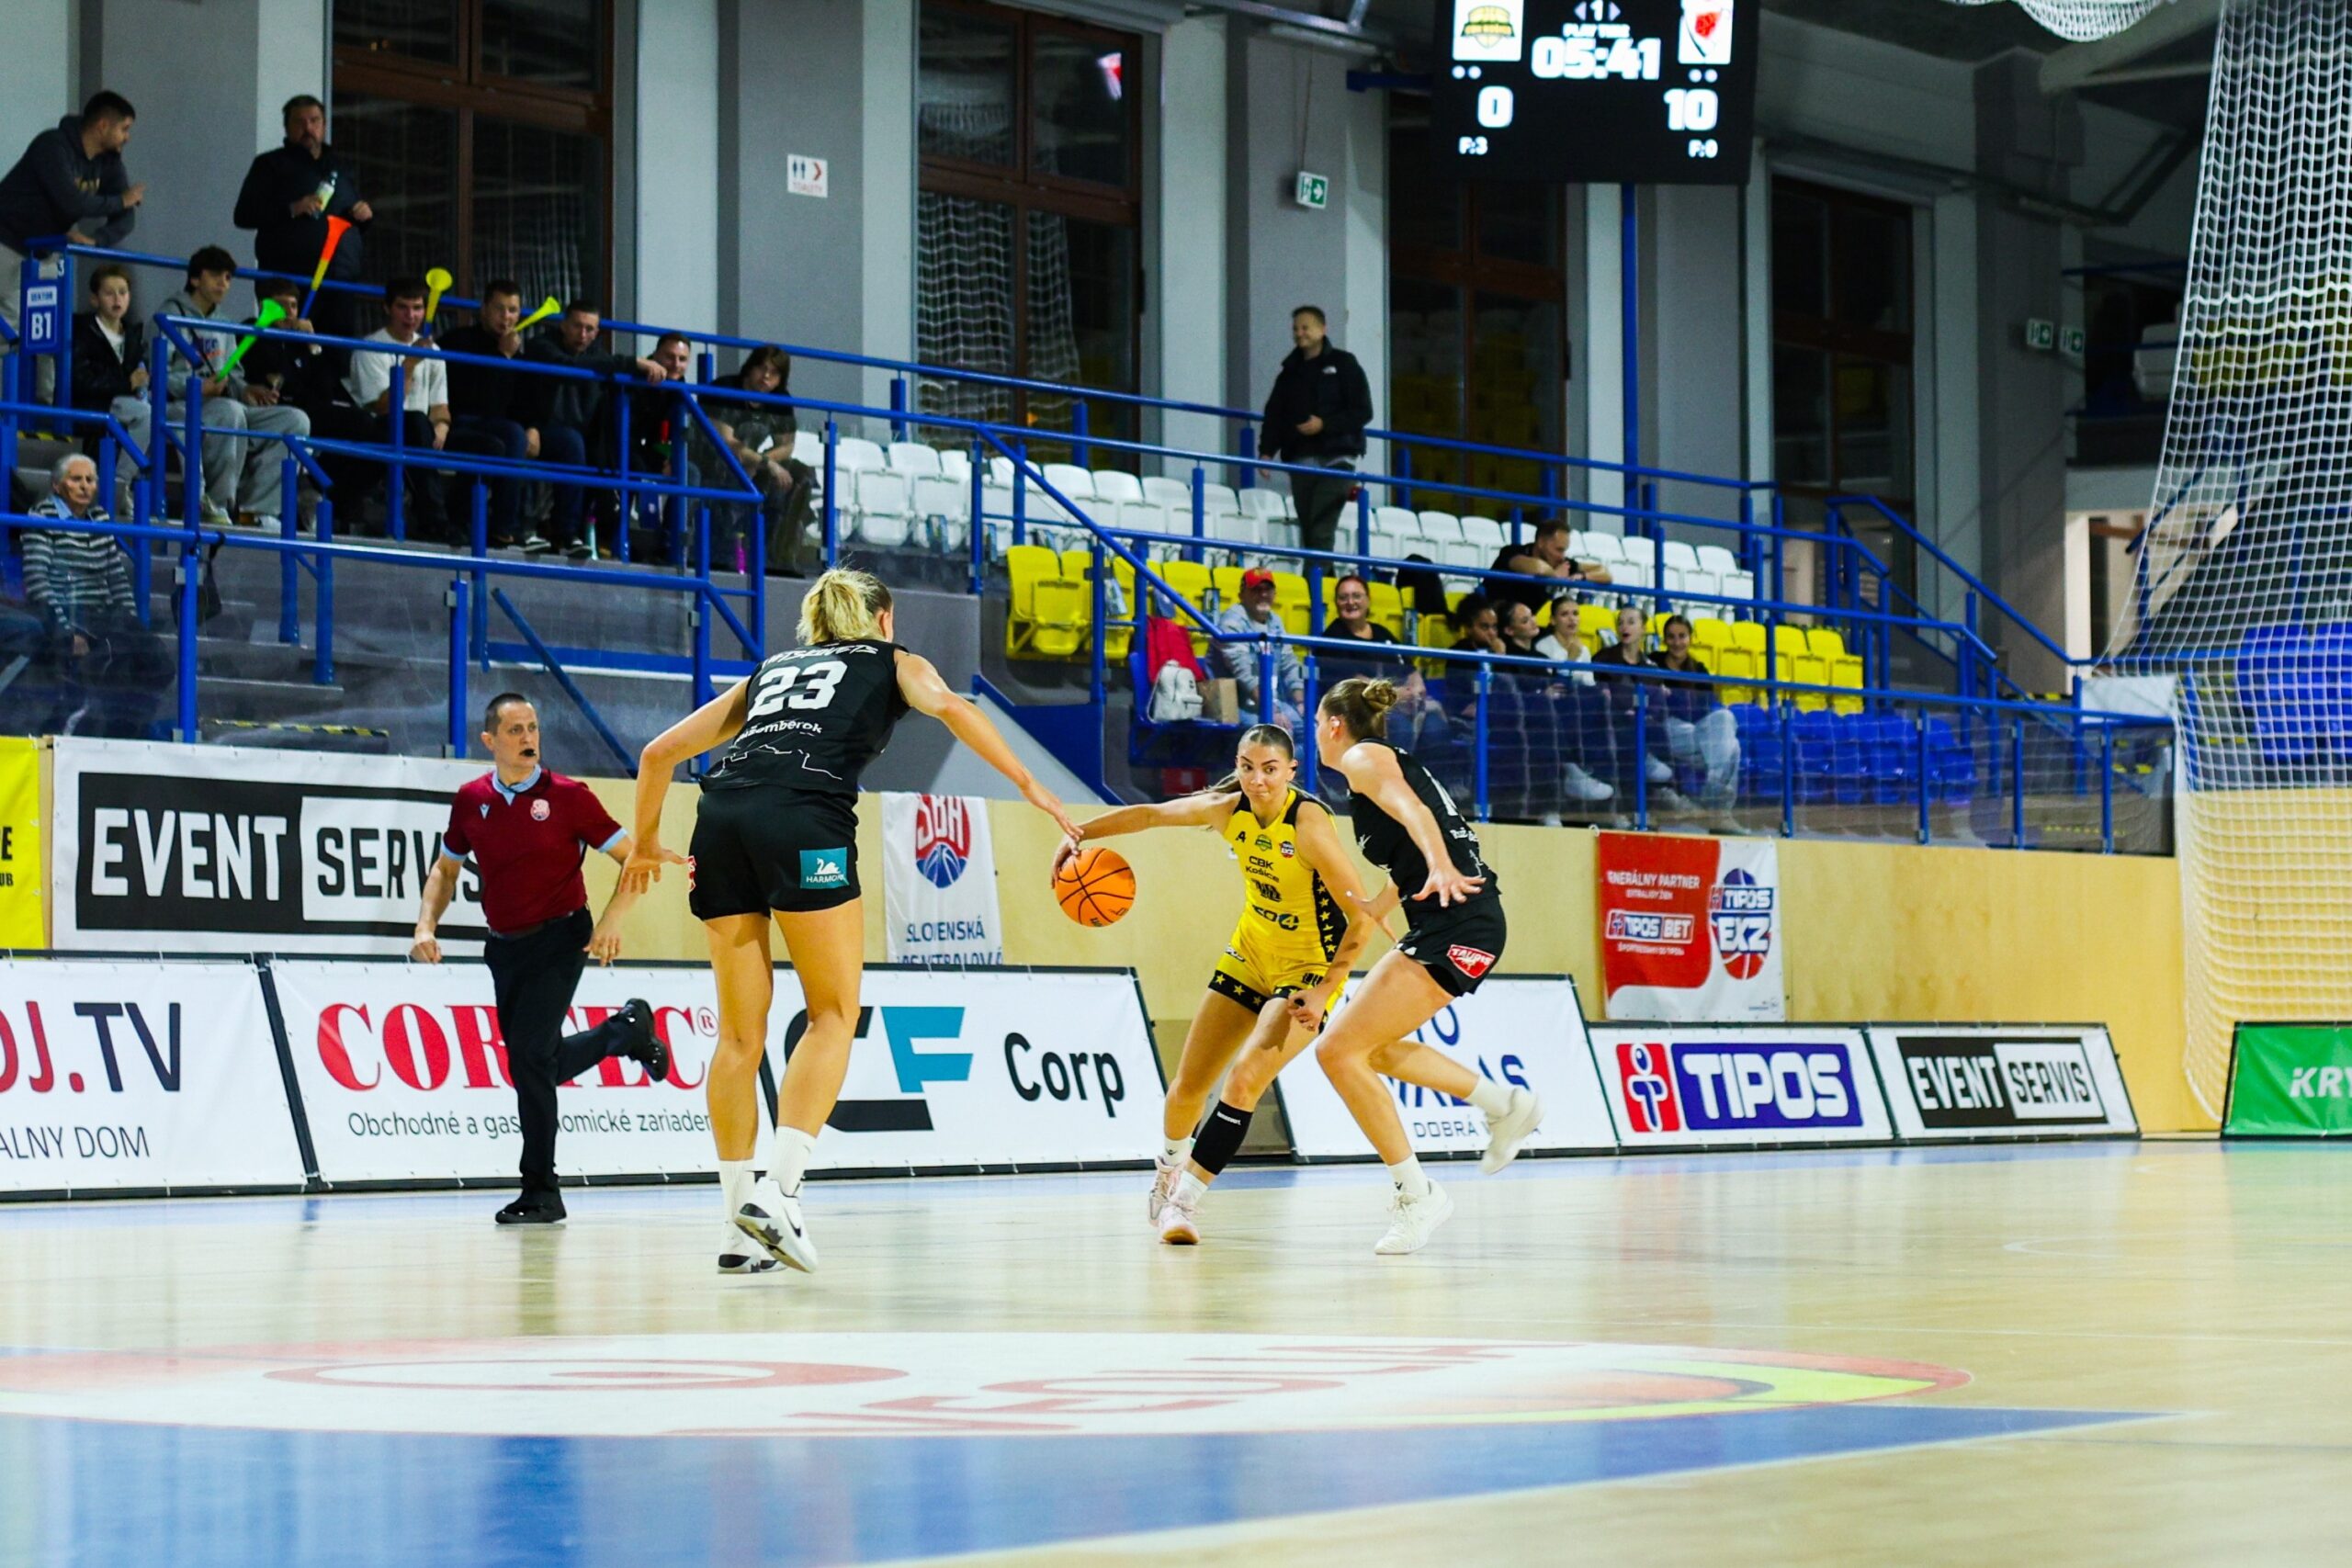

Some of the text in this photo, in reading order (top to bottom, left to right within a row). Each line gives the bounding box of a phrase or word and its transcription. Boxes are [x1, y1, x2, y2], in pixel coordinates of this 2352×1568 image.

[1589, 0, 1603, 21] 1
[1531, 37, 1661, 80] 05:41
[1477, 86, 1514, 128] 0
[1663, 89, 1718, 130] 10
[31, 311, 52, 341] B1
[747, 660, 848, 722] 23
[91, 807, 485, 903] EVENT SERVS
[1249, 855, 1274, 871] CBK
[1724, 889, 1771, 909] TIPOS
[906, 916, 986, 942] SLOENSKÁ
[1664, 919, 1691, 939] BET
[1004, 1032, 1125, 1118] Corp
[1681, 1051, 1849, 1120] TIPOS
[1907, 1056, 2092, 1110] EVENT SERVIS
[348, 1110, 460, 1136] Obchodné
[467, 1117, 480, 1134] a
[74, 1126, 150, 1158] DOM
